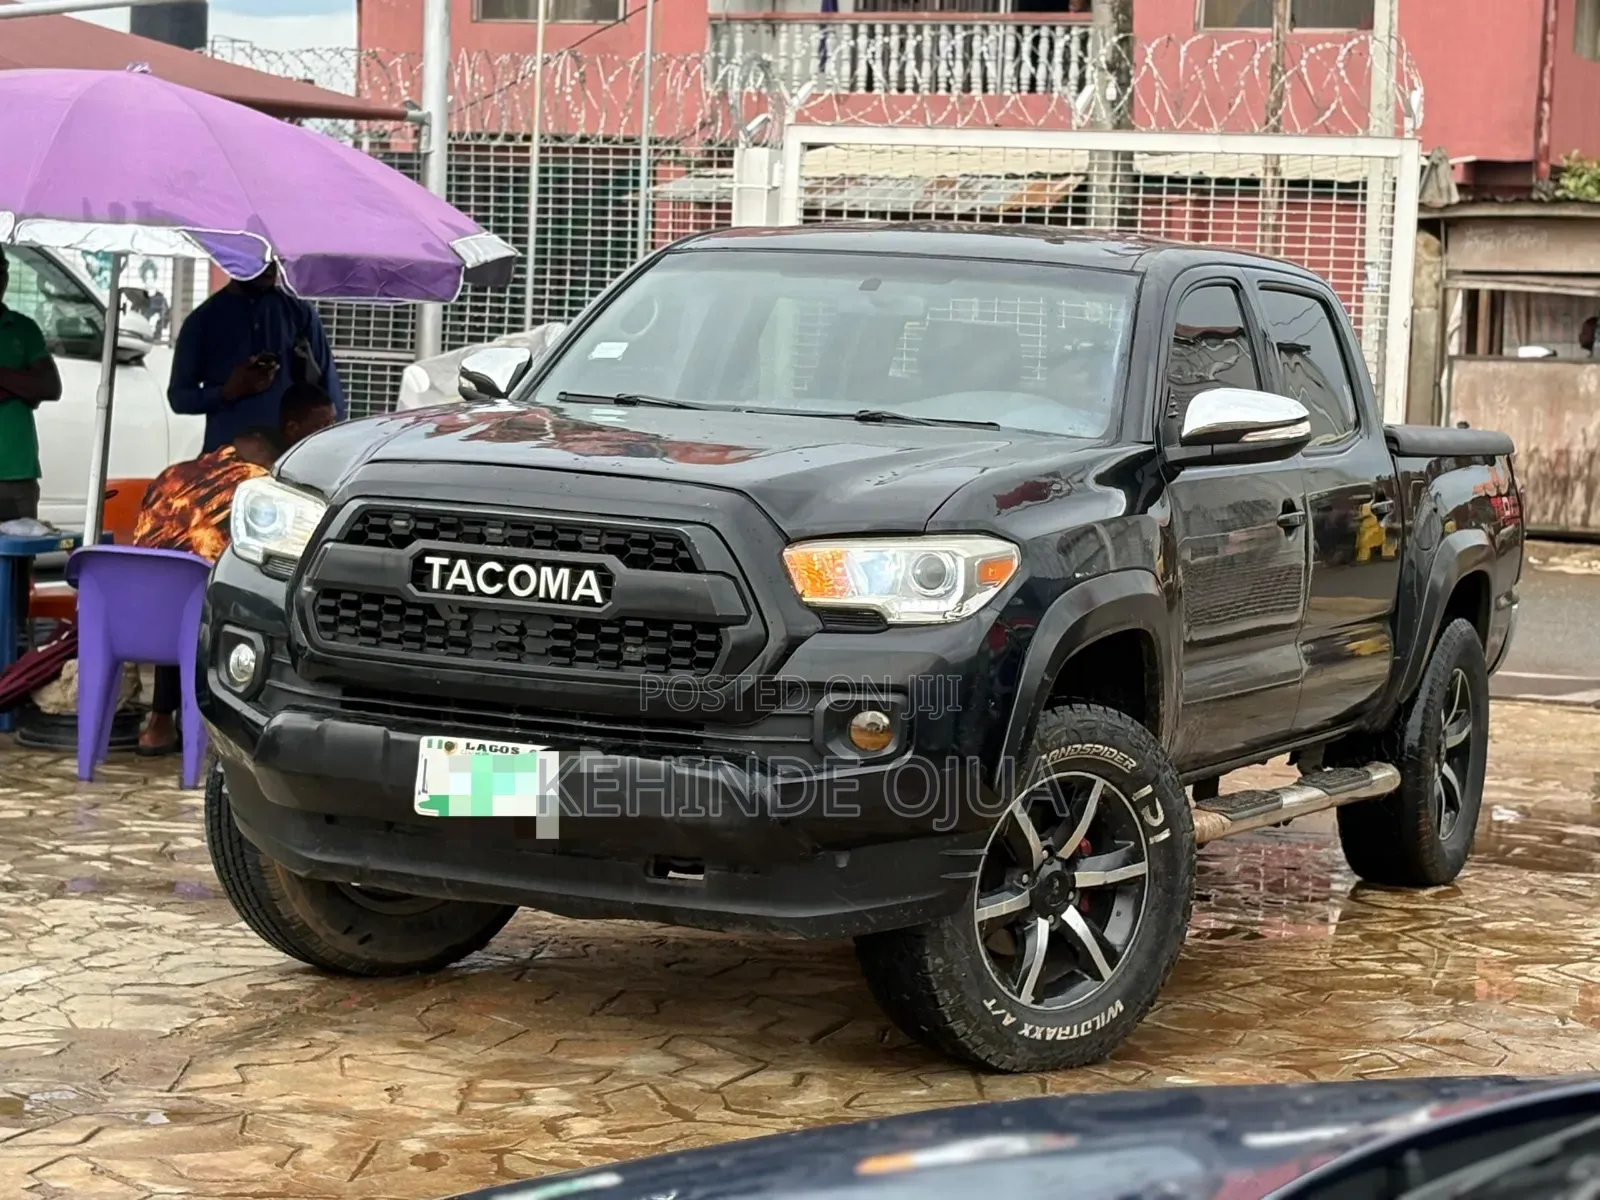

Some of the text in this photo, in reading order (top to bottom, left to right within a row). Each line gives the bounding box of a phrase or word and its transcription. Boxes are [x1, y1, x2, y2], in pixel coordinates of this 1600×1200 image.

[424, 556, 603, 603] TACOMA
[465, 742, 520, 755] LAGOS
[982, 998, 1125, 1041] WILDTRAXX A/T
